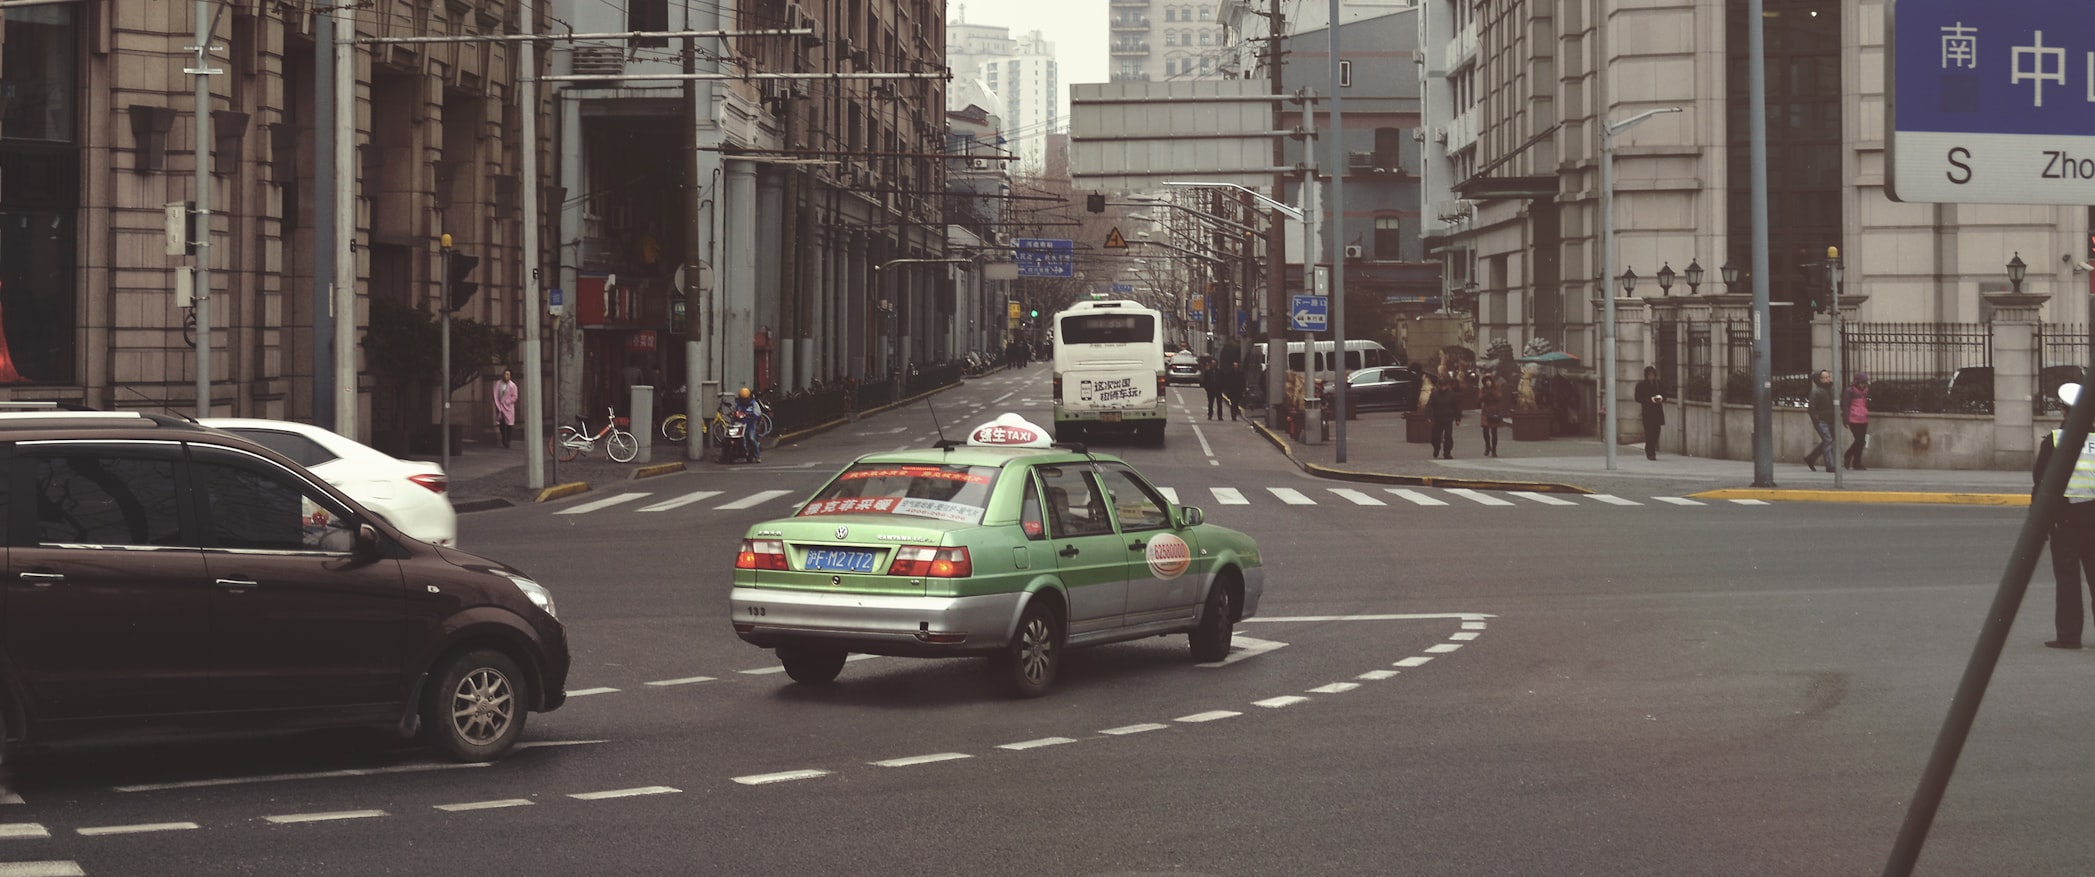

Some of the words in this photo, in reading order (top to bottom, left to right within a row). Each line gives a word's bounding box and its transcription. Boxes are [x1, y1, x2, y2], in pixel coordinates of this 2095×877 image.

[1940, 21, 1978, 69] 南
[1946, 147, 1972, 185] S
[1007, 430, 1032, 442] TAXI
[747, 605, 767, 617] 133
